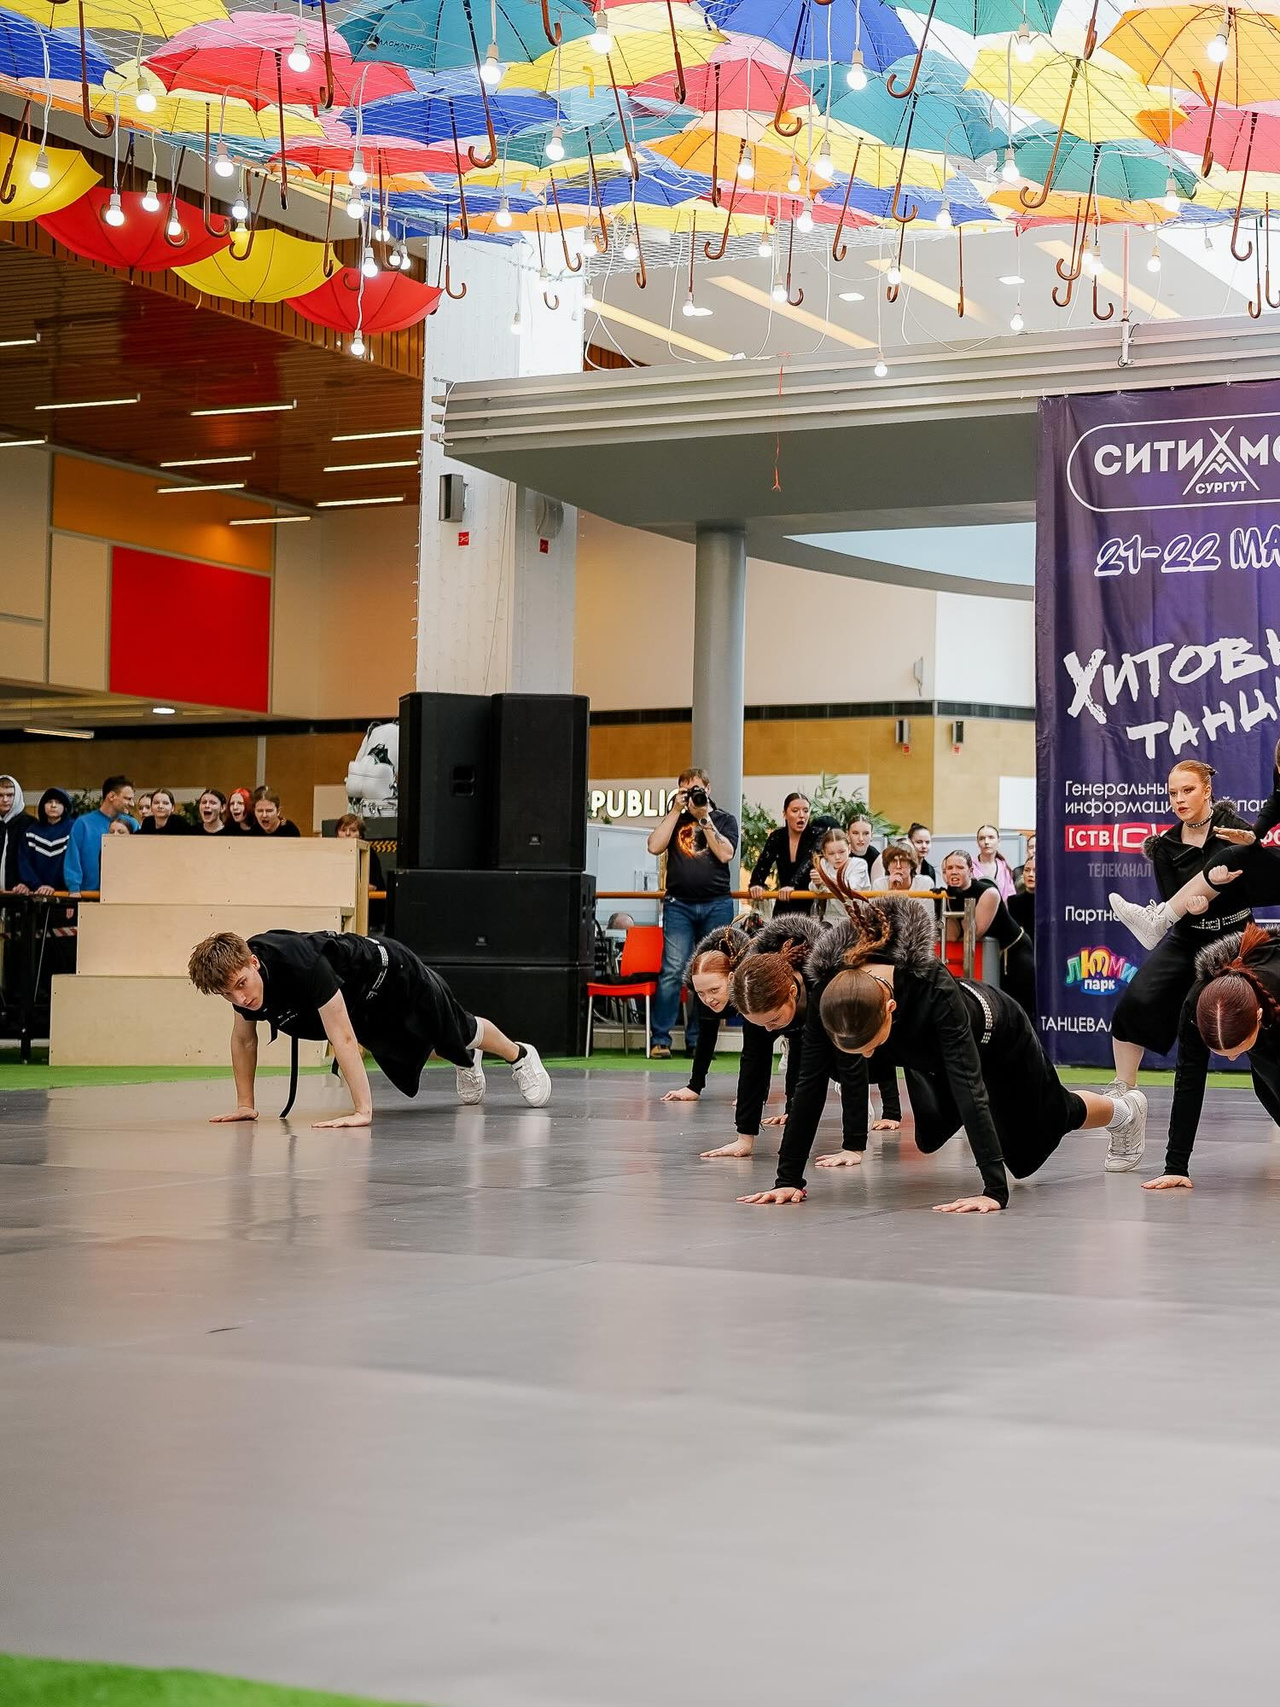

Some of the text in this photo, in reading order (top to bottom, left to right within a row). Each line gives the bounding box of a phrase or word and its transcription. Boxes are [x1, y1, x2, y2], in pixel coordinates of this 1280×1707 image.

[1094, 438, 1202, 475] СИТИ
[1195, 480, 1247, 494] СУРГУТ
[1094, 533, 1222, 577] 21-22
[1065, 780, 1168, 799] Генеральны
[1065, 798, 1175, 817] информаци
[1088, 863, 1152, 878] ТЕЛЕКАНАЛ
[1065, 905, 1122, 925] Партн
[1084, 979, 1116, 992] парк
